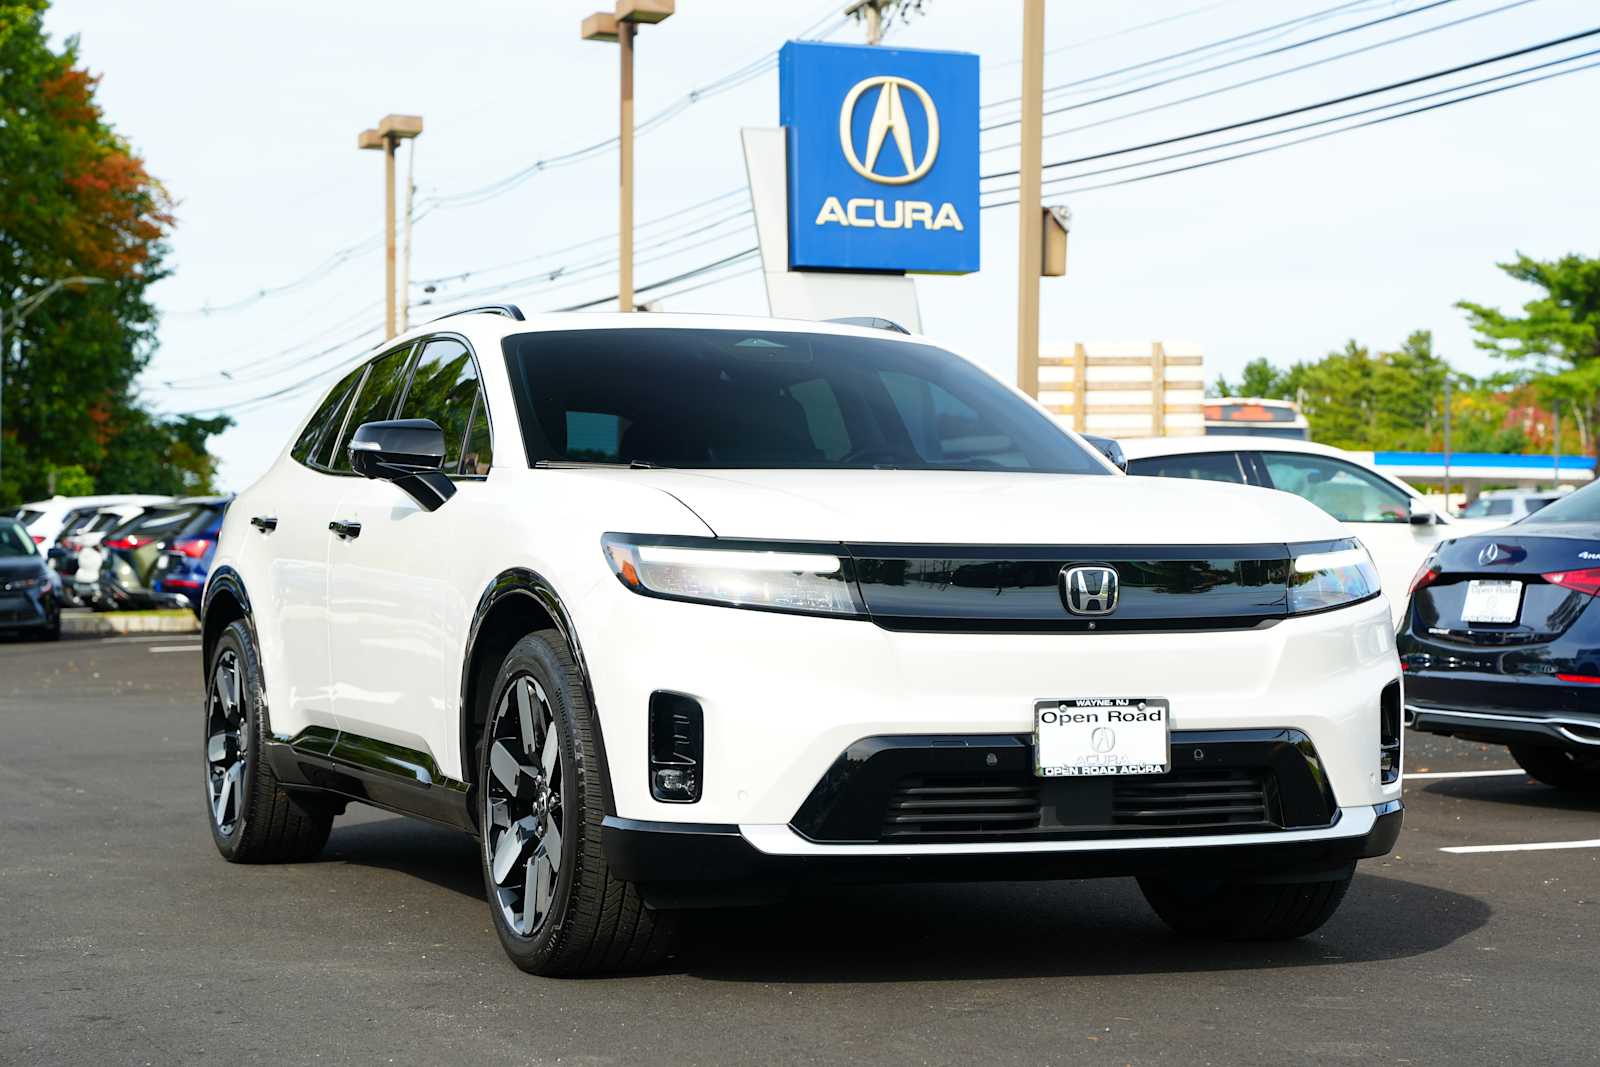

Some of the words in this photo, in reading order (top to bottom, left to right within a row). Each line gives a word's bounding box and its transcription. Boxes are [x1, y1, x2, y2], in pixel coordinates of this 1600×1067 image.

[815, 196, 964, 231] ACURA
[1041, 711, 1099, 726] Open
[1107, 710, 1162, 722] Road
[1074, 754, 1130, 766] ACURA
[1044, 766, 1079, 777] OPEN
[1081, 765, 1117, 776] ROAD
[1119, 764, 1164, 775] ACURA
